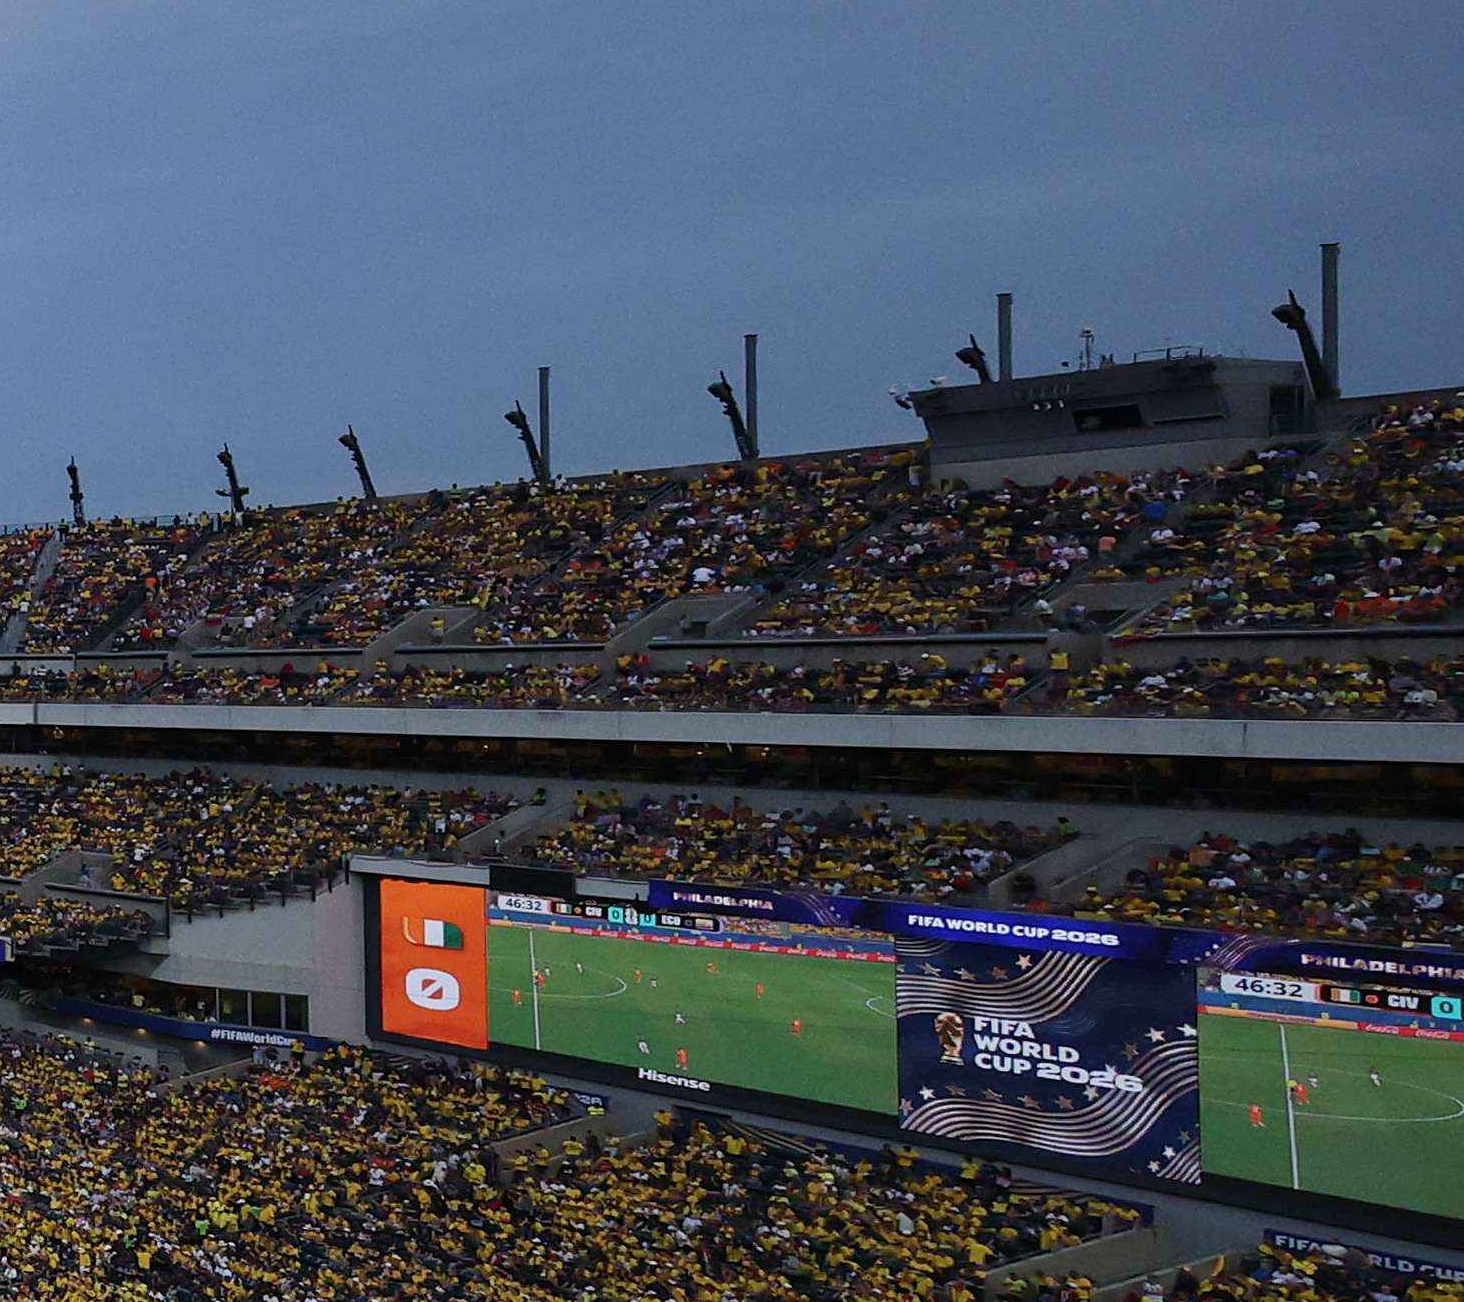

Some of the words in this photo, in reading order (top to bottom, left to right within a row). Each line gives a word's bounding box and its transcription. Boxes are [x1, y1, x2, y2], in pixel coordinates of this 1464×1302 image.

[505, 899, 542, 911] 46:32
[673, 891, 773, 911] PHILADELPHIA
[908, 914, 944, 929] FIFA
[946, 918, 1010, 935] WORLD
[1012, 925, 1050, 939] CUP
[1052, 929, 1120, 946] 2026
[1235, 978, 1303, 998] 46:32
[1388, 993, 1419, 1010] CIV
[973, 1016, 1036, 1039] FIFA
[973, 1033, 1080, 1063] WORLD
[638, 1067, 711, 1092] Hisense
[974, 1053, 1032, 1075] CUP
[1036, 1062, 1145, 1093] 2026
